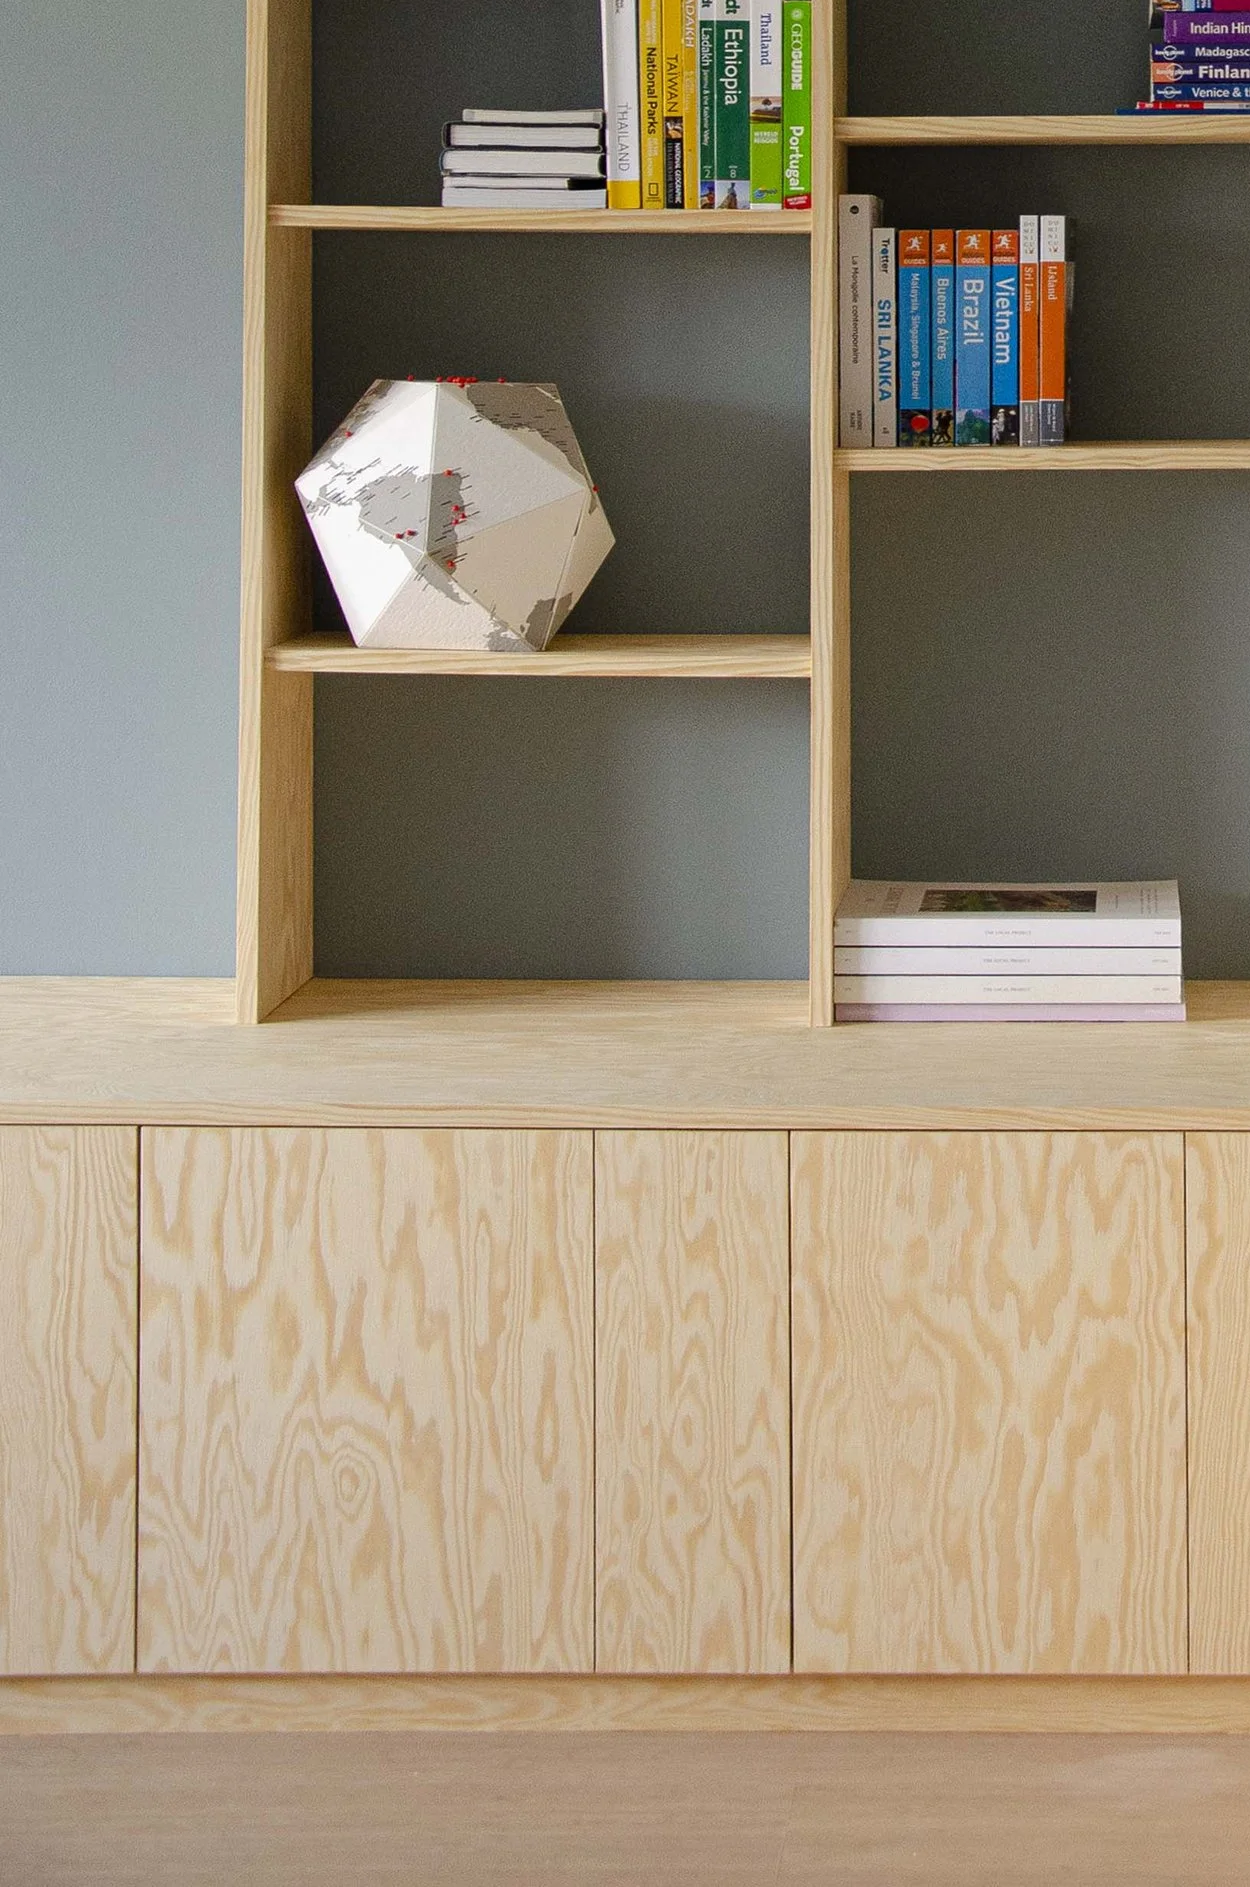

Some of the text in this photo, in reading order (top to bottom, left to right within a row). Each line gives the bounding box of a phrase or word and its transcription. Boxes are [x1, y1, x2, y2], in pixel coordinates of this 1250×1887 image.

[701, 27, 712, 66] Ladakh
[760, 13, 772, 66] Thailand
[1189, 21, 1229, 35] Indian
[646, 47, 658, 99] National
[719, 28, 743, 106] Ethiopia
[791, 23, 803, 90] GEOGUIDE
[1191, 87, 1229, 97] Venice
[1232, 87, 1242, 97] &
[617, 103, 630, 172] THAILAND
[646, 101, 659, 135] Parks
[674, 142, 682, 169] NATIONAL
[704, 169, 712, 179] 2
[729, 169, 737, 179] 8
[785, 125, 805, 191] Portugal
[880, 238, 891, 274] Trotter
[850, 255, 859, 364] La Mongolie contemporaine
[937, 278, 950, 323] Buenos
[962, 278, 985, 345] Brazil
[1024, 266, 1034, 313] Sri Lanka
[909, 315, 921, 359] Singapore
[995, 277, 1016, 364] Vietnam
[878, 299, 892, 402] SRI LANKA
[911, 360, 921, 368] &
[936, 326, 949, 361] Aires
[911, 369, 921, 400] Brunei
